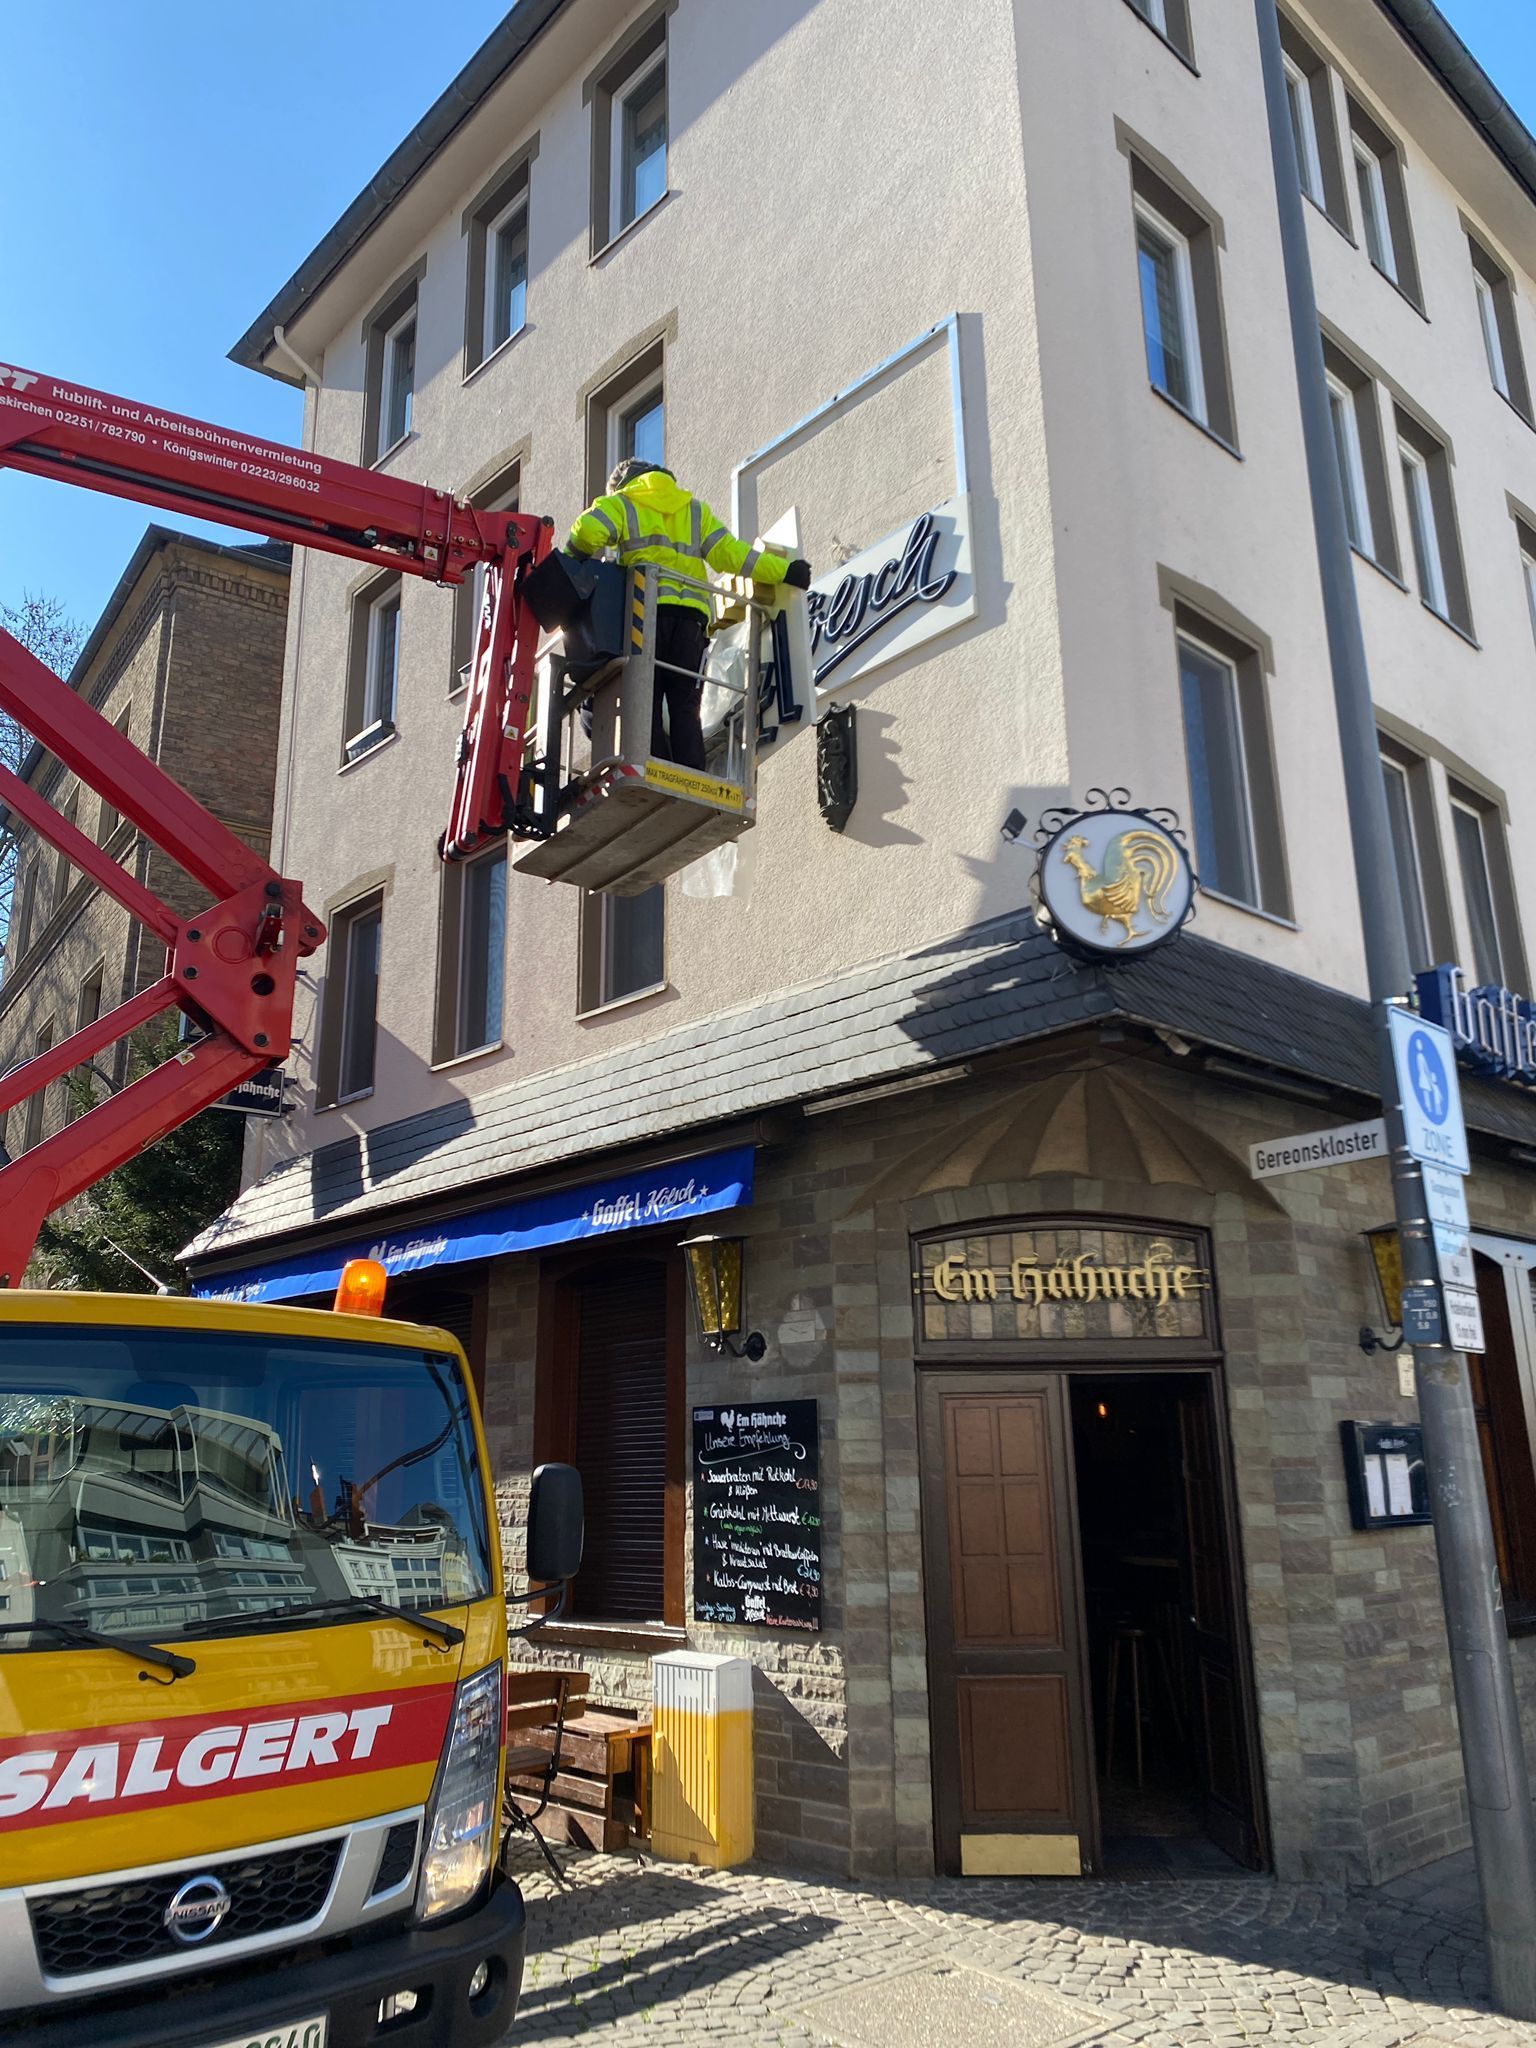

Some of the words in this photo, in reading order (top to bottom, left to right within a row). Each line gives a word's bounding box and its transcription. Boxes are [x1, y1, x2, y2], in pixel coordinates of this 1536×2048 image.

[51, 385, 108, 412] Hublift-
[112, 403, 140, 422] und
[144, 413, 322, 474] Arbeitsbühnenvermietung
[163, 439, 238, 470] Königswinter
[1256, 1130, 1379, 1171] Gereonskloster
[1422, 1127, 1454, 1159] ZONE
[591, 1192, 641, 1226] Gaffel
[644, 1178, 697, 1218] Kölsch
[933, 1251, 998, 1301] Em
[1010, 1251, 1192, 1307] Hähnche
[736, 1413, 750, 1427] Em
[751, 1412, 787, 1428] Hähnche
[705, 1432, 738, 1451] Unsere
[739, 1428, 790, 1450] Empfehlung
[0, 1704, 393, 1818] SALGERT
[172, 1900, 227, 1921] NISSAN
